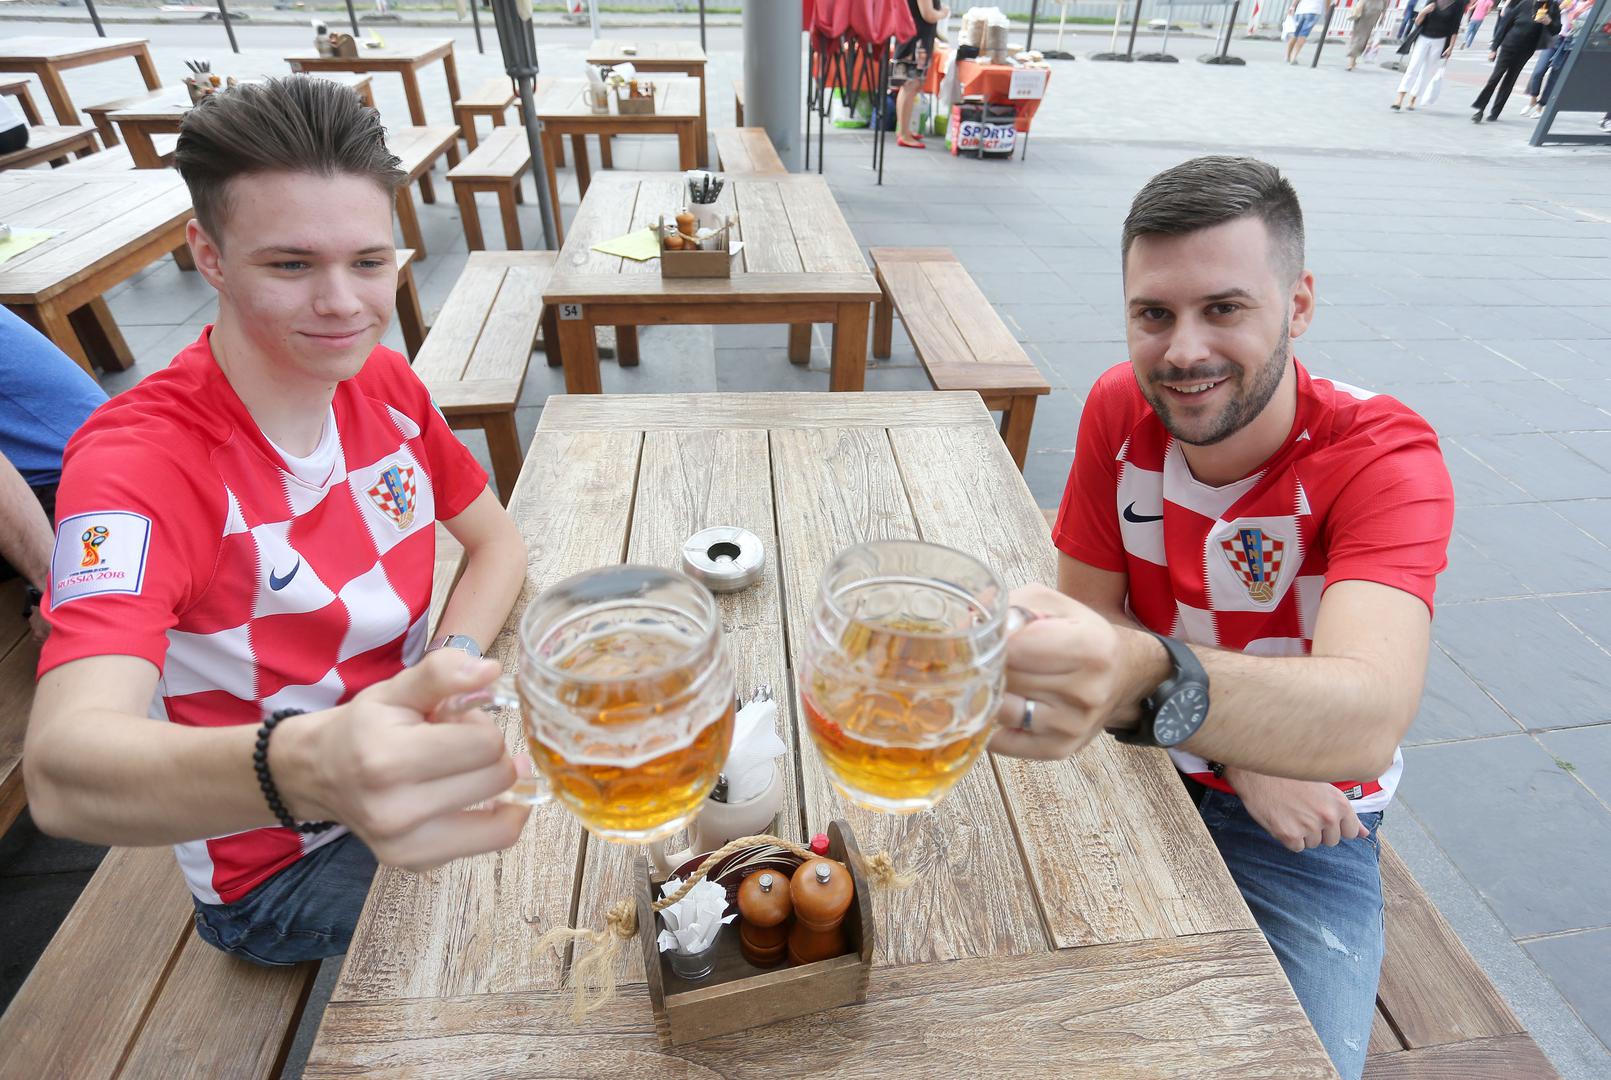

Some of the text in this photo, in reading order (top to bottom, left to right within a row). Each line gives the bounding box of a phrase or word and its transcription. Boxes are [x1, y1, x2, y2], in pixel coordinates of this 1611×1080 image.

[962, 125, 1014, 139] SPORTS
[564, 305, 577, 317] 54
[1246, 534, 1260, 575] HNS
[58, 574, 95, 590] RUSSIA
[96, 571, 126, 580] 2018
